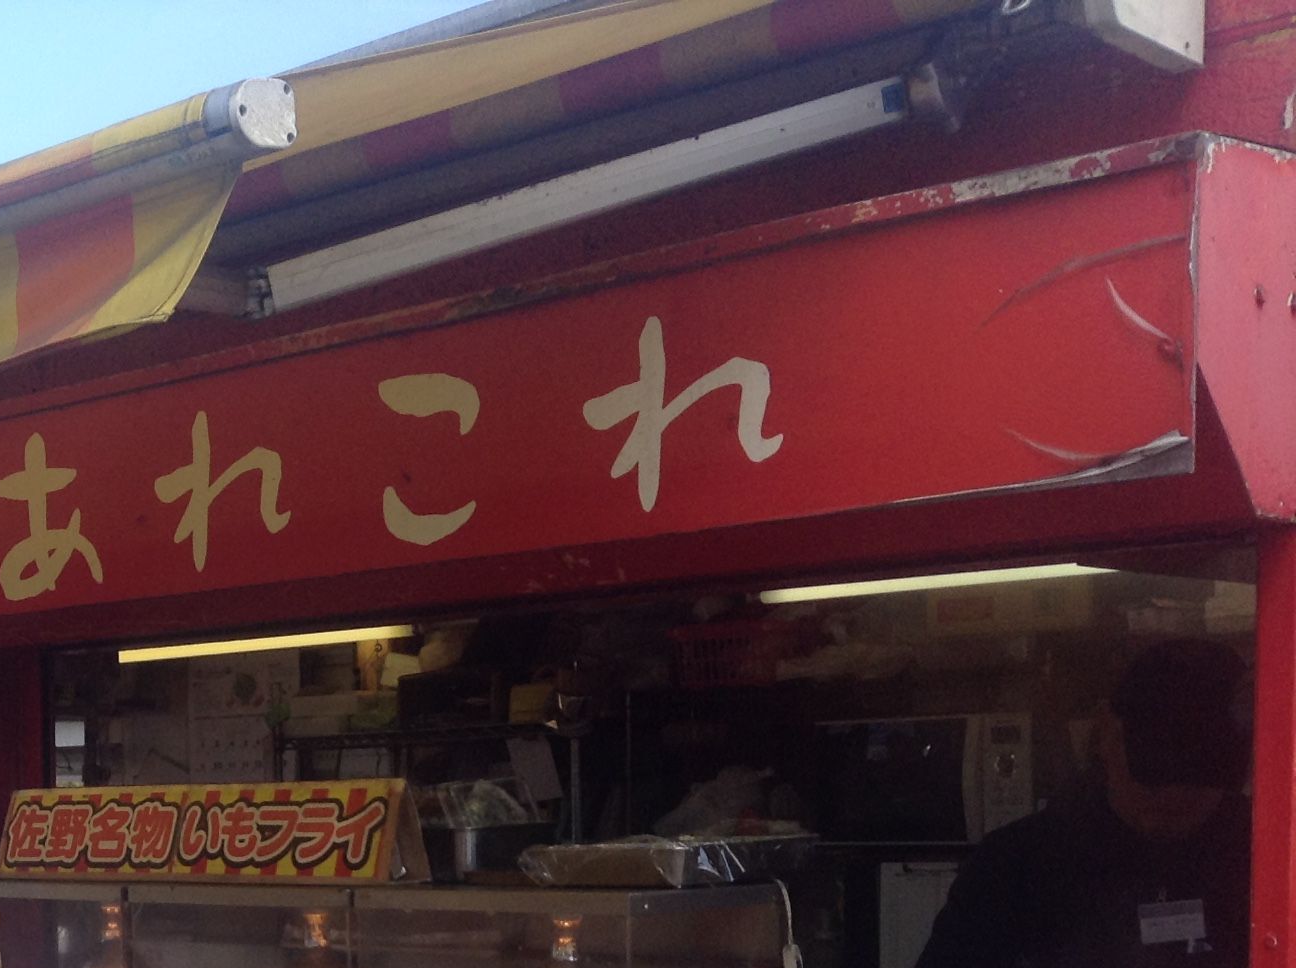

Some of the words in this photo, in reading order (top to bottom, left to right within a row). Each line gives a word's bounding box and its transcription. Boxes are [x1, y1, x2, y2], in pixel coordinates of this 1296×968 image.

[8, 801, 384, 863] 佐野名物いもフライ
